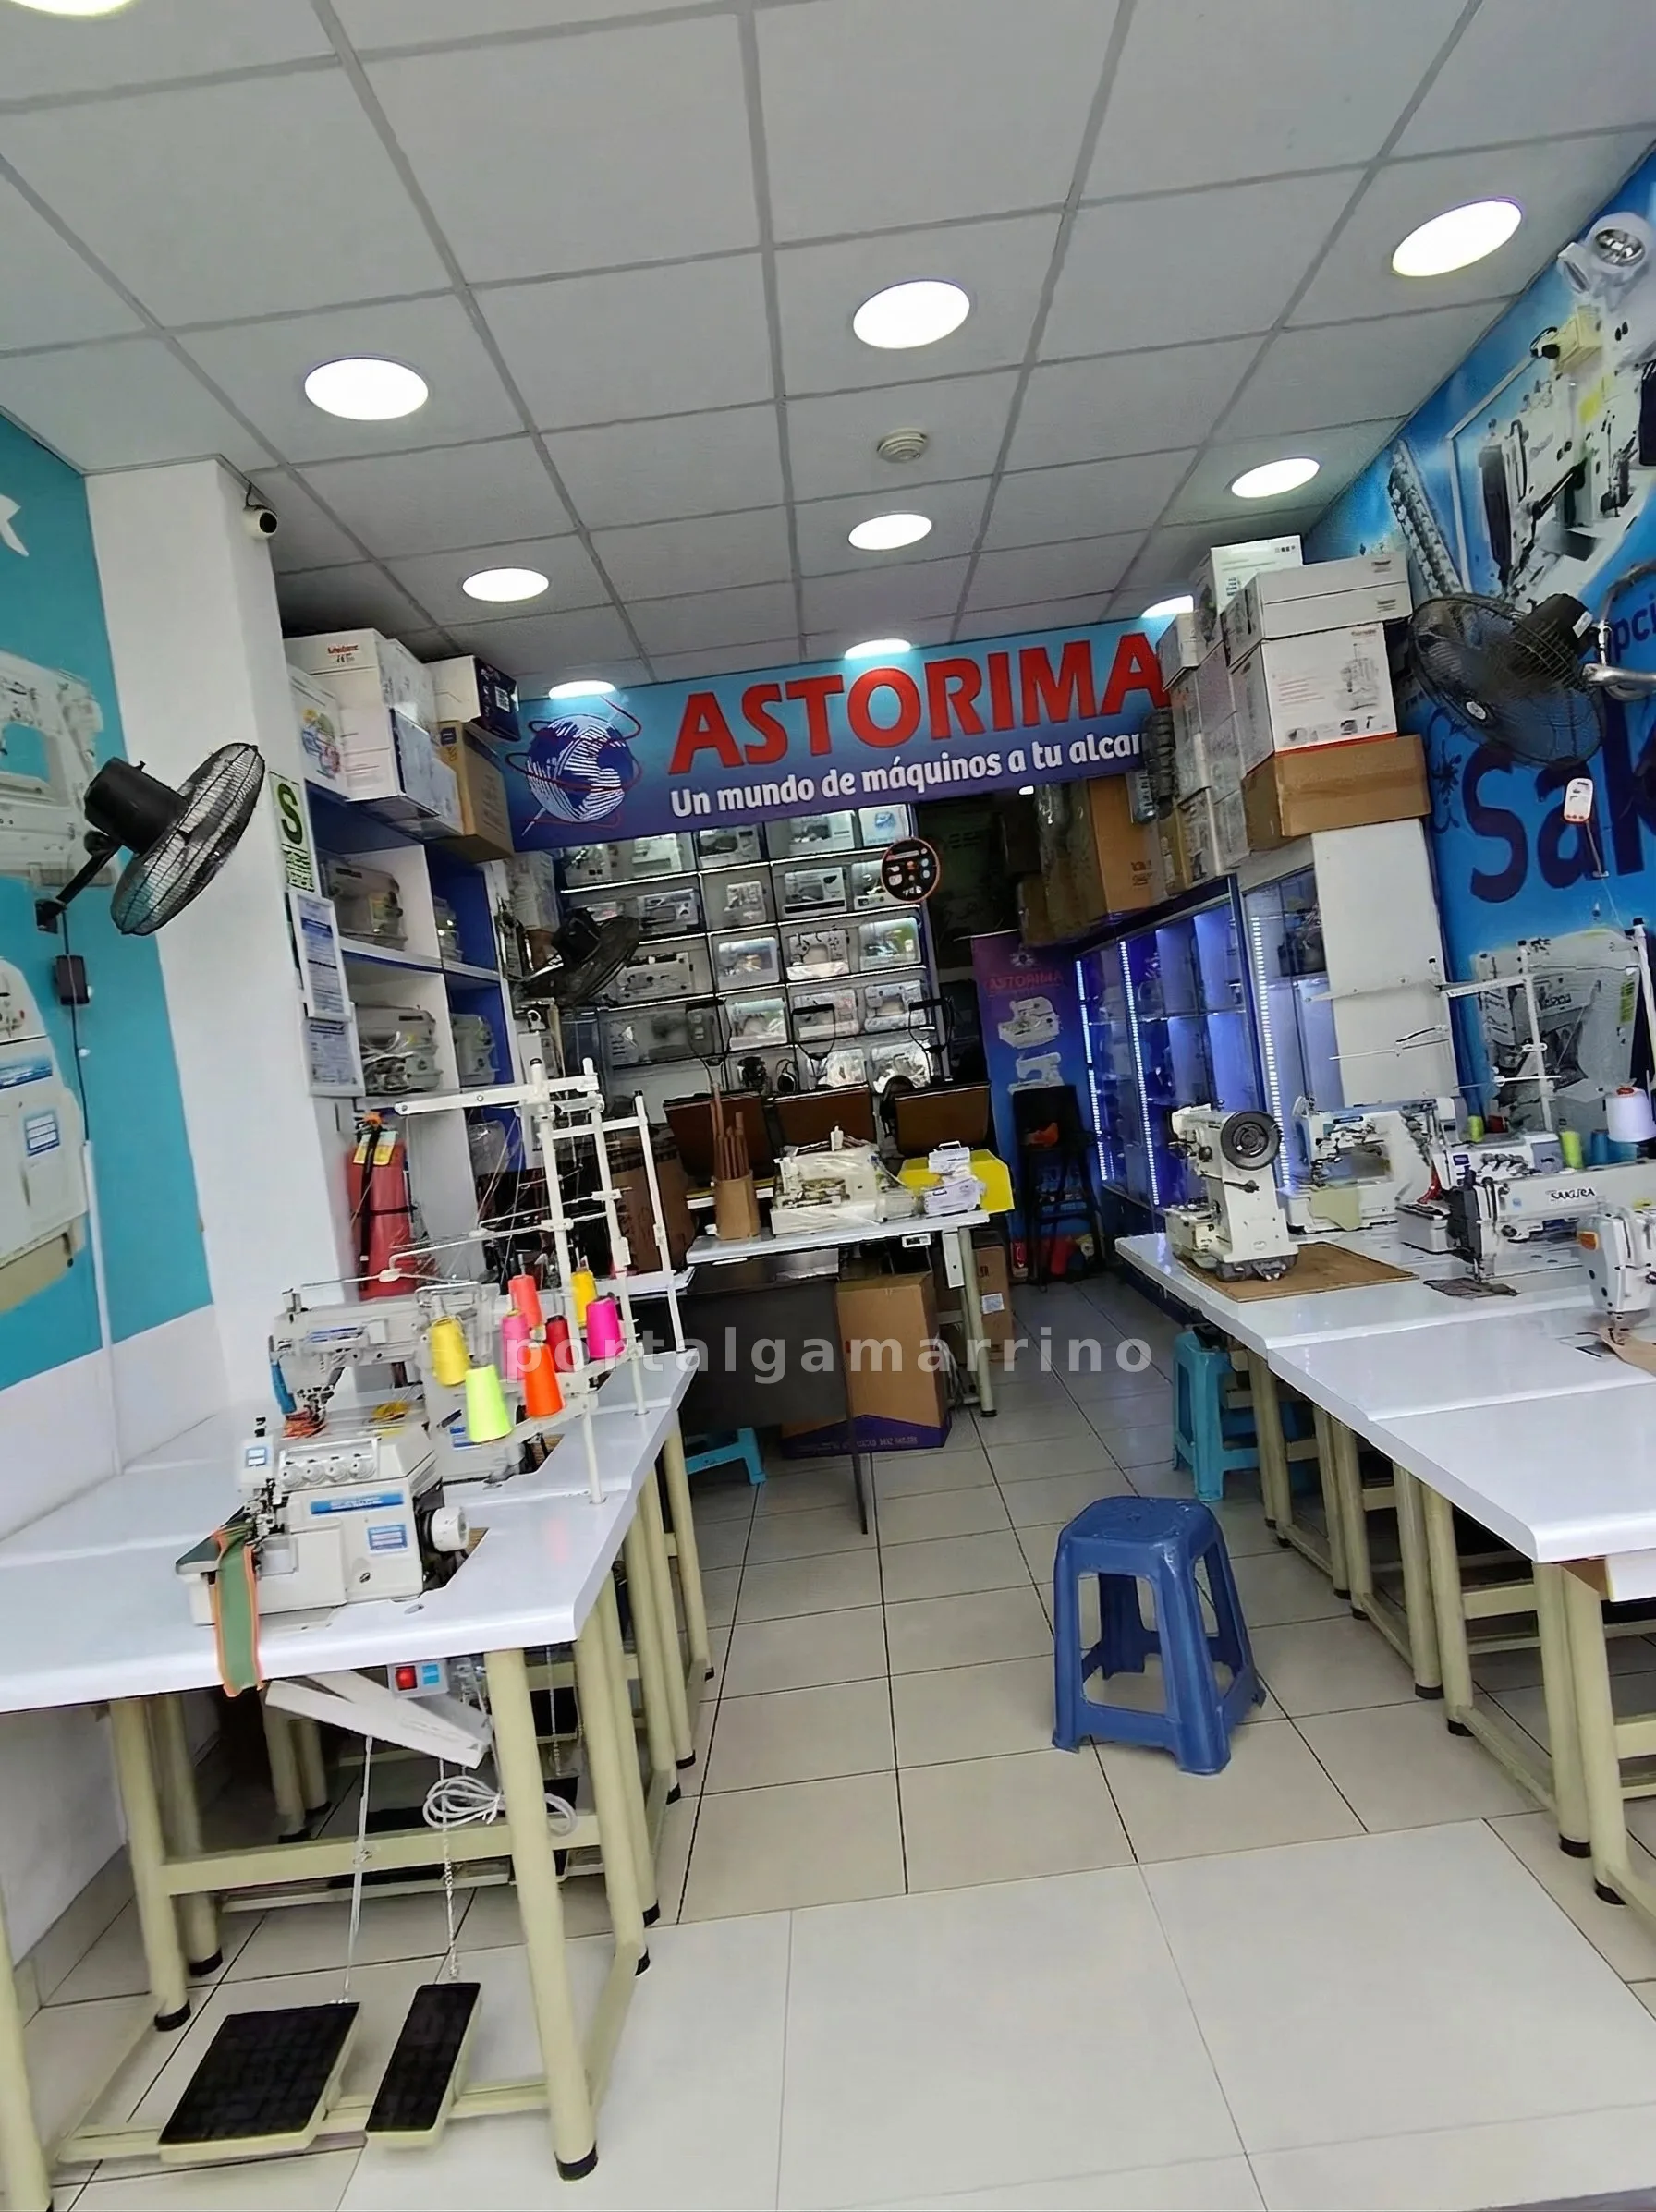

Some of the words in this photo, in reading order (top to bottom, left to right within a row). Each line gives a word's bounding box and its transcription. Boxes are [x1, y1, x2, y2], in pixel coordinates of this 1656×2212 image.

[669, 632, 1171, 774] ASTORIMA
[278, 784, 303, 845] S
[671, 788, 711, 817] Un
[717, 774, 814, 811] mundo
[822, 769, 856, 797] de
[1008, 749, 1027, 773] a
[1032, 741, 1063, 770] tu
